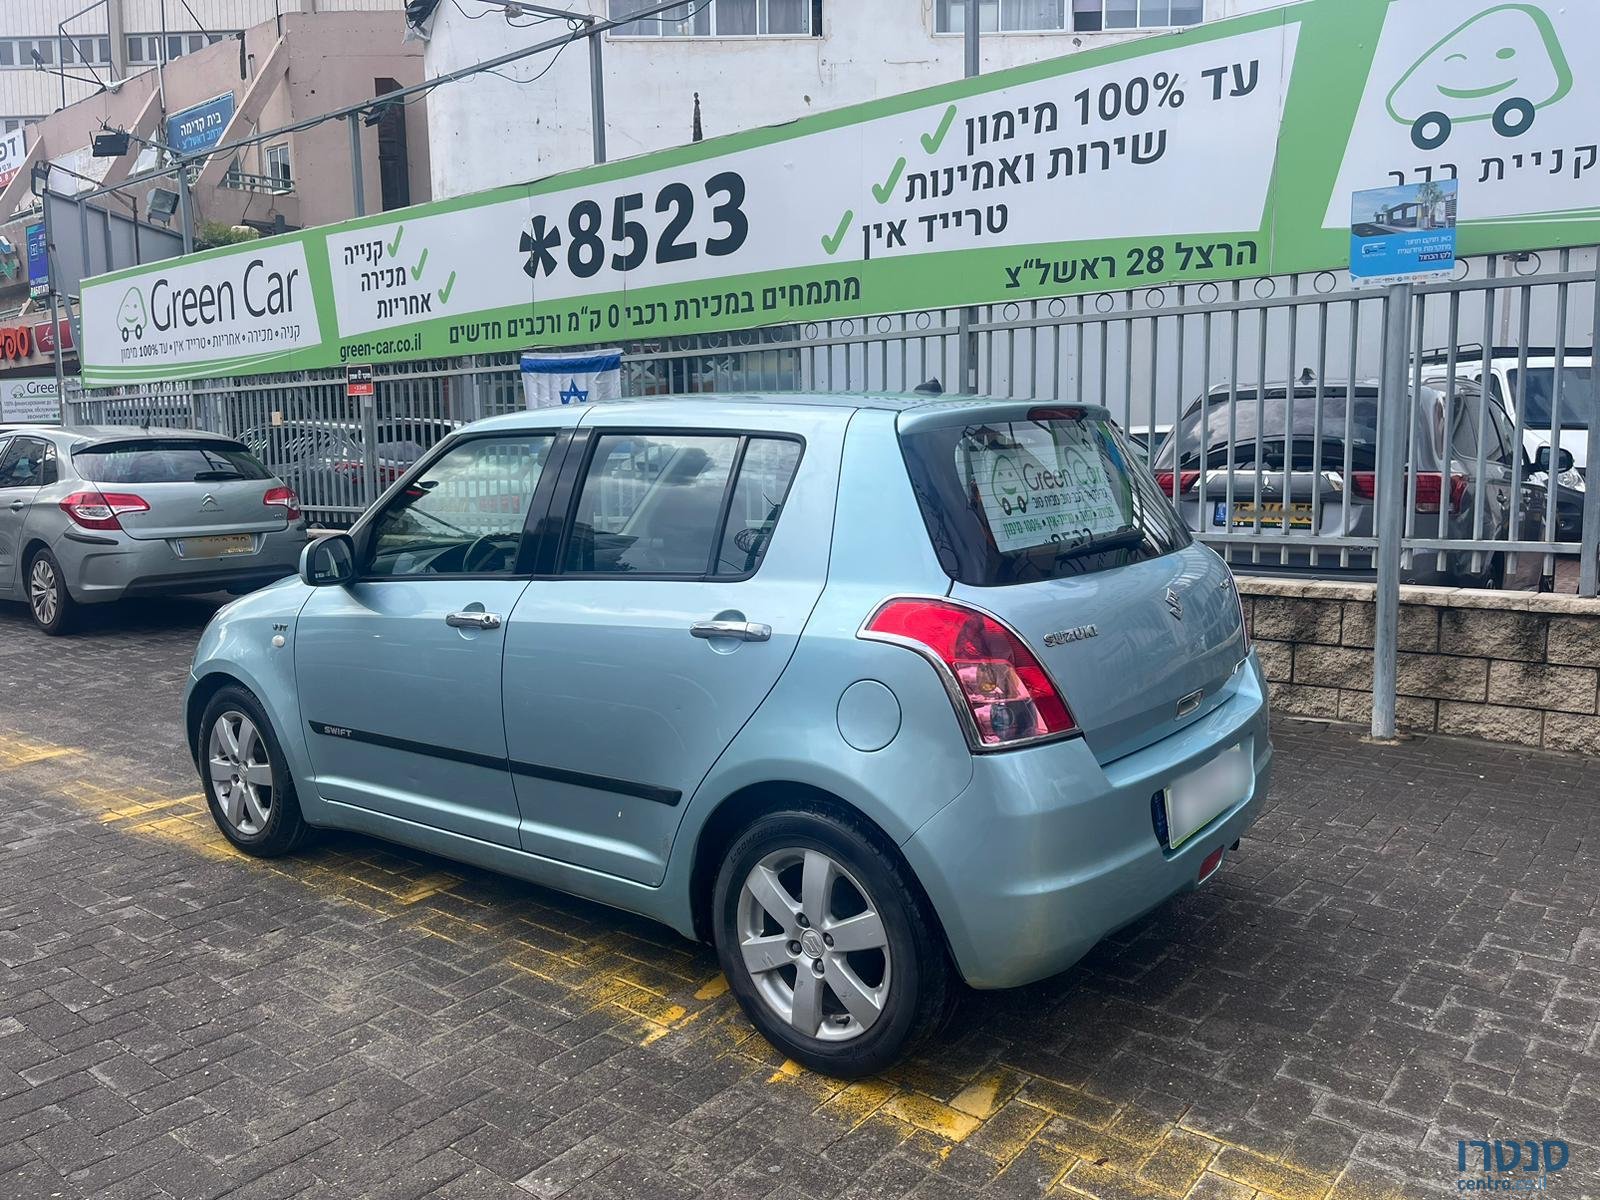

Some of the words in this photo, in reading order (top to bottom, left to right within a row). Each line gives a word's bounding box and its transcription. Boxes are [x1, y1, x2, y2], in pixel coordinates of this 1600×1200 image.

[1202, 59, 1259, 101] עד
[1074, 71, 1185, 126] 100%
[965, 100, 1058, 156] מימון
[1047, 129, 1167, 180] שירות
[1478, 144, 1598, 183] קניית
[905, 153, 1034, 202] ואמינות
[918, 203, 1009, 243] טרייד
[862, 218, 907, 260] אין
[344, 240, 384, 267] קנייה
[1126, 246, 1165, 276] 28
[1175, 239, 1257, 272] הרצל
[361, 266, 407, 292] מכירה
[151, 278, 236, 332] Green
[243, 259, 299, 318] Car
[377, 293, 432, 320] אחריות
[674, 290, 754, 322] במכירת
[762, 276, 861, 310] מתמחים
[507, 314, 561, 338] ורכבים
[608, 303, 620, 328] 0
[625, 302, 668, 326] רכבי
[186, 337, 206, 350] טרייד
[212, 332, 241, 348] אחריות
[248, 329, 274, 344] מכירה
[281, 325, 301, 342] קניה
[449, 321, 502, 344] חדשים
[140, 344, 159, 357] 100%
[159, 343, 168, 354] עד
[173, 341, 184, 357] אין
[340, 332, 422, 362] green-car.co.il
[1023, 463, 1073, 491] Green
[1043, 624, 1098, 648] SUZUKI
[324, 726, 353, 738] SWIFT
